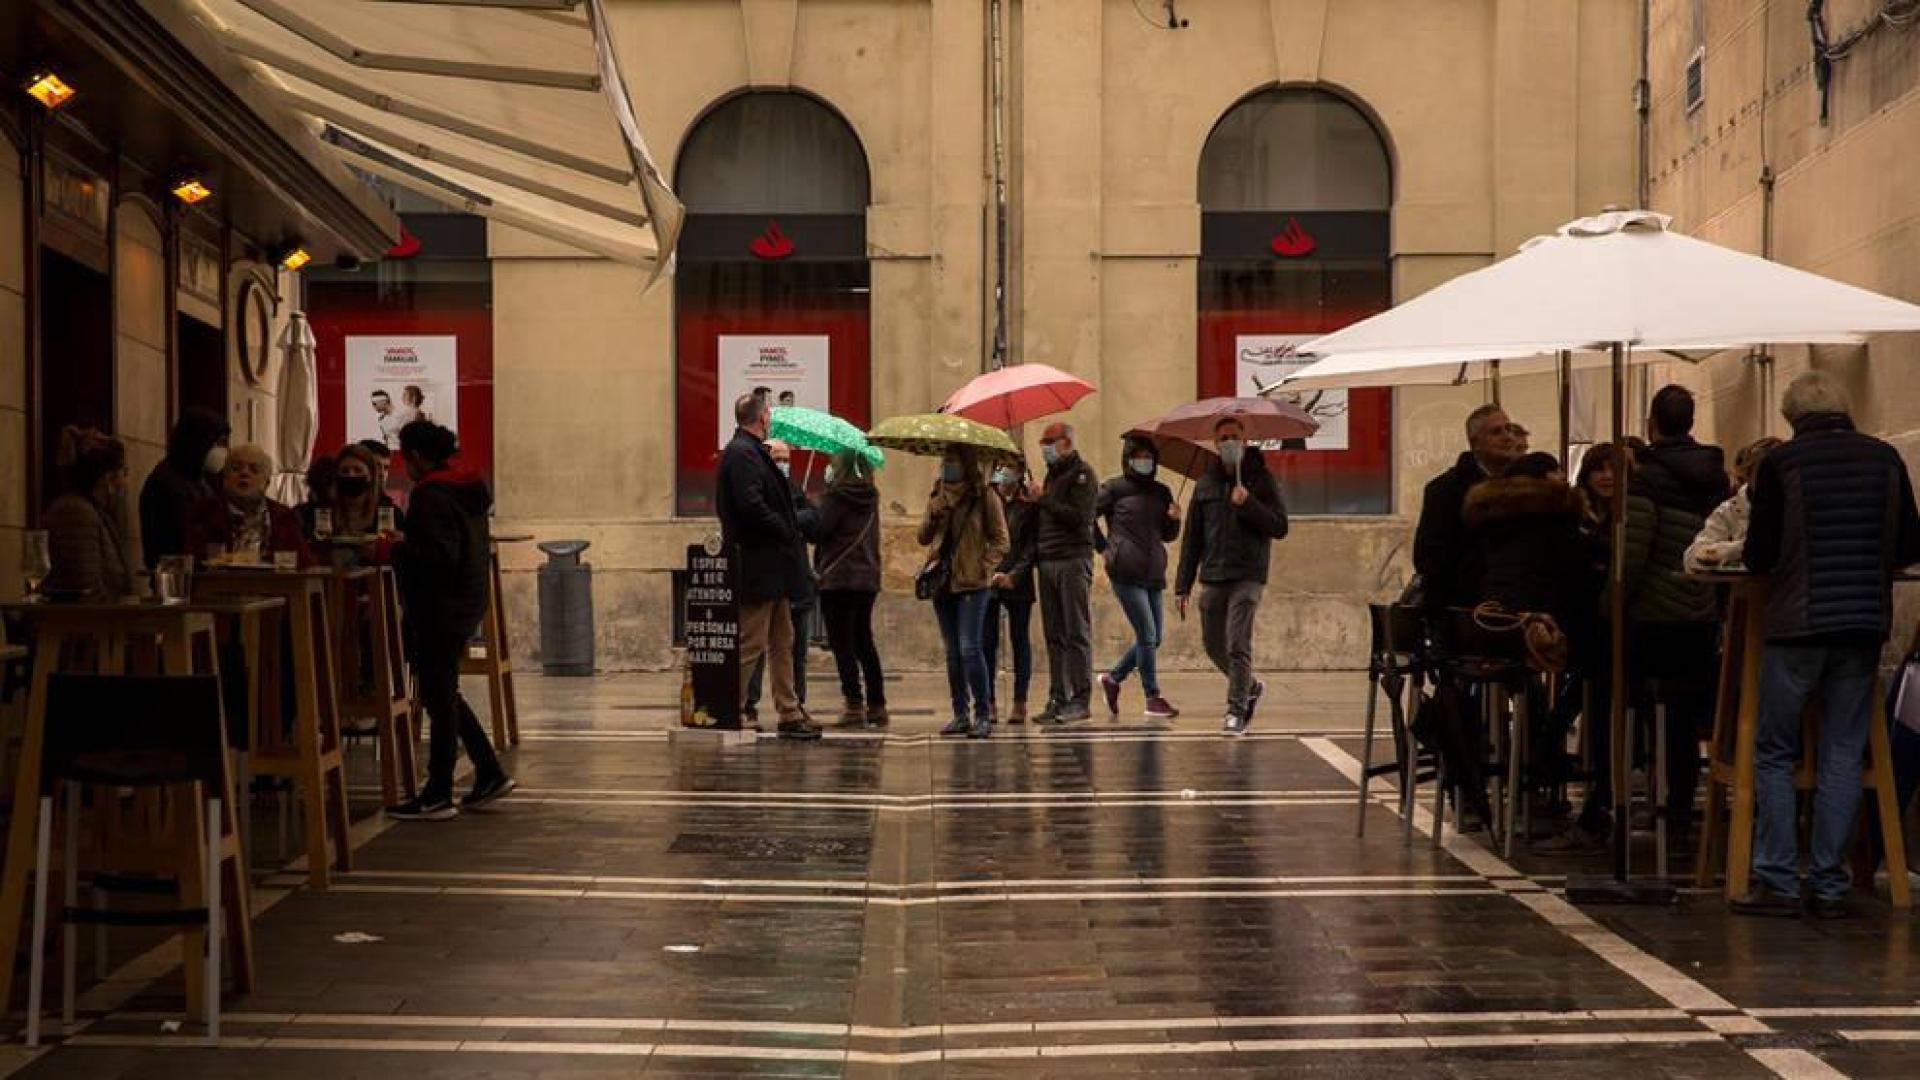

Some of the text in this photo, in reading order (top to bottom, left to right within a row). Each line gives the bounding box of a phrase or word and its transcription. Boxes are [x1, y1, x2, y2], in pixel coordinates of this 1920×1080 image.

[691, 557, 727, 570] ESPERE
[691, 571, 724, 585] A SER
[687, 587, 732, 601] ATENDIDO
[686, 621, 738, 634] PERSONAS
[687, 636, 734, 650] POR MESA
